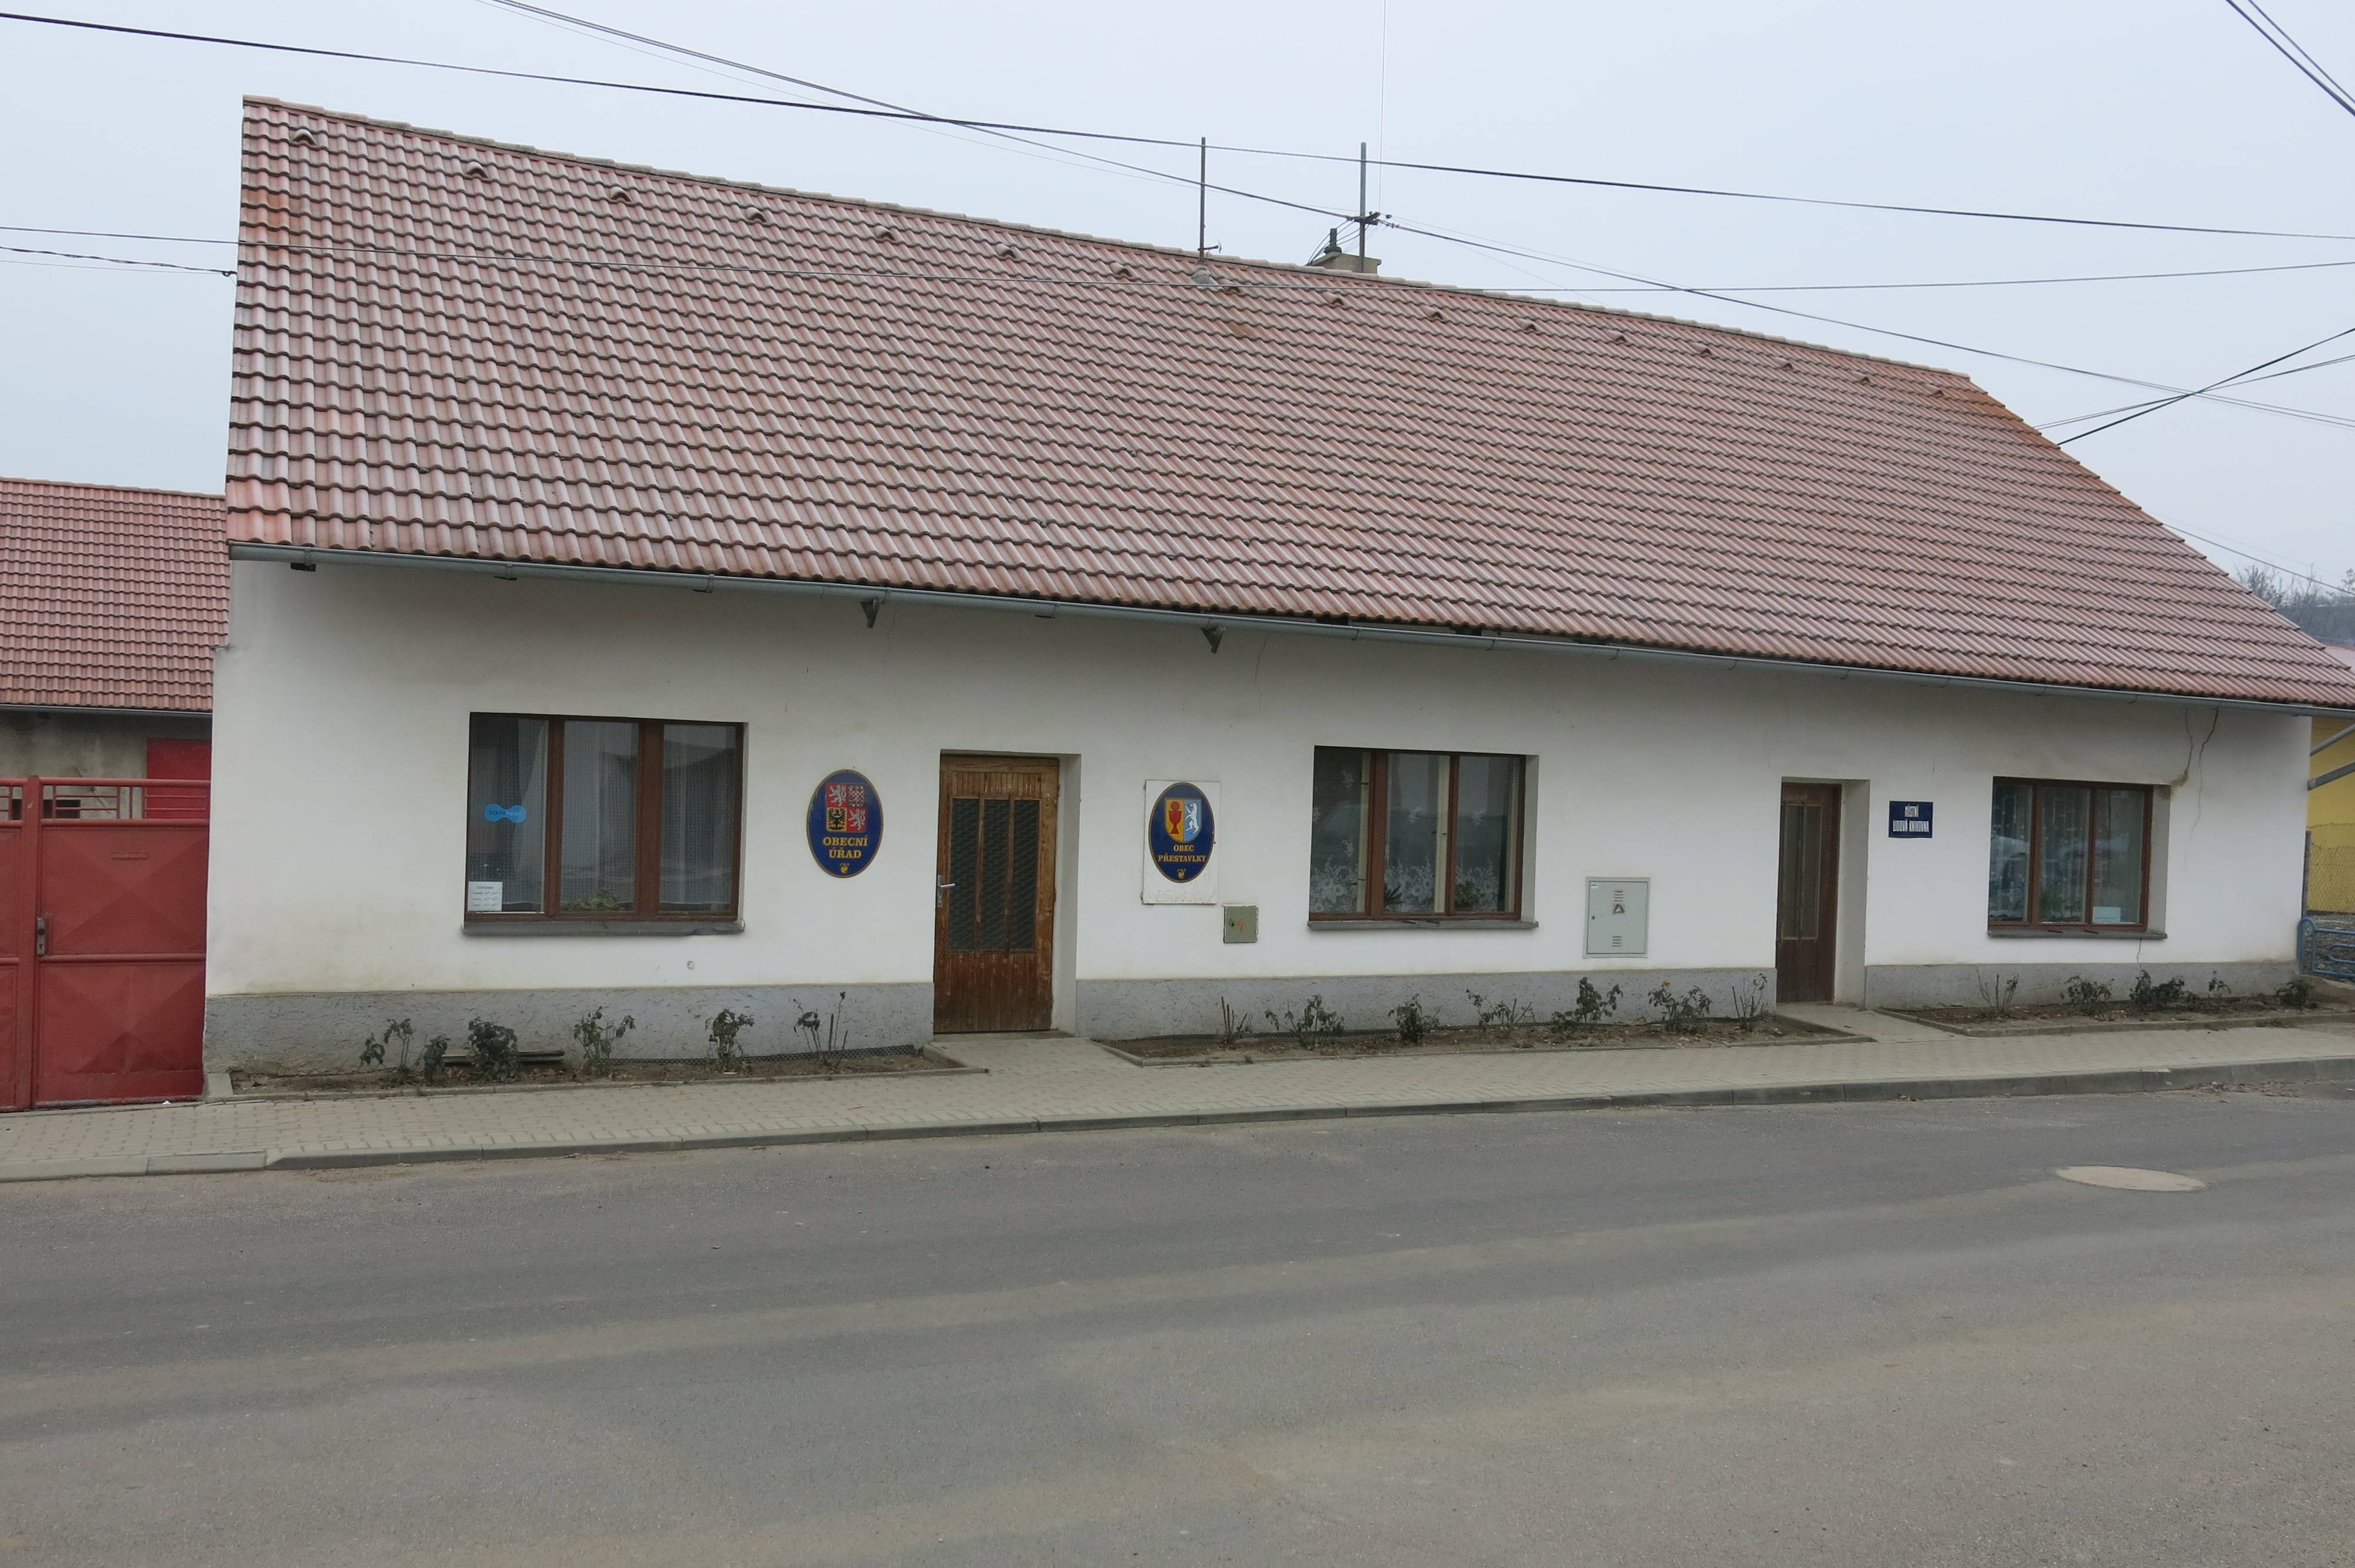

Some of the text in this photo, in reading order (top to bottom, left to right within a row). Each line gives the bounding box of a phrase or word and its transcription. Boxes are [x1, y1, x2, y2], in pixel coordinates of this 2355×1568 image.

[822, 835, 868, 846] OBECNÍ
[829, 846, 862, 859] ÚŘAD
[1157, 853, 1207, 862] PŘESTAVLKY
